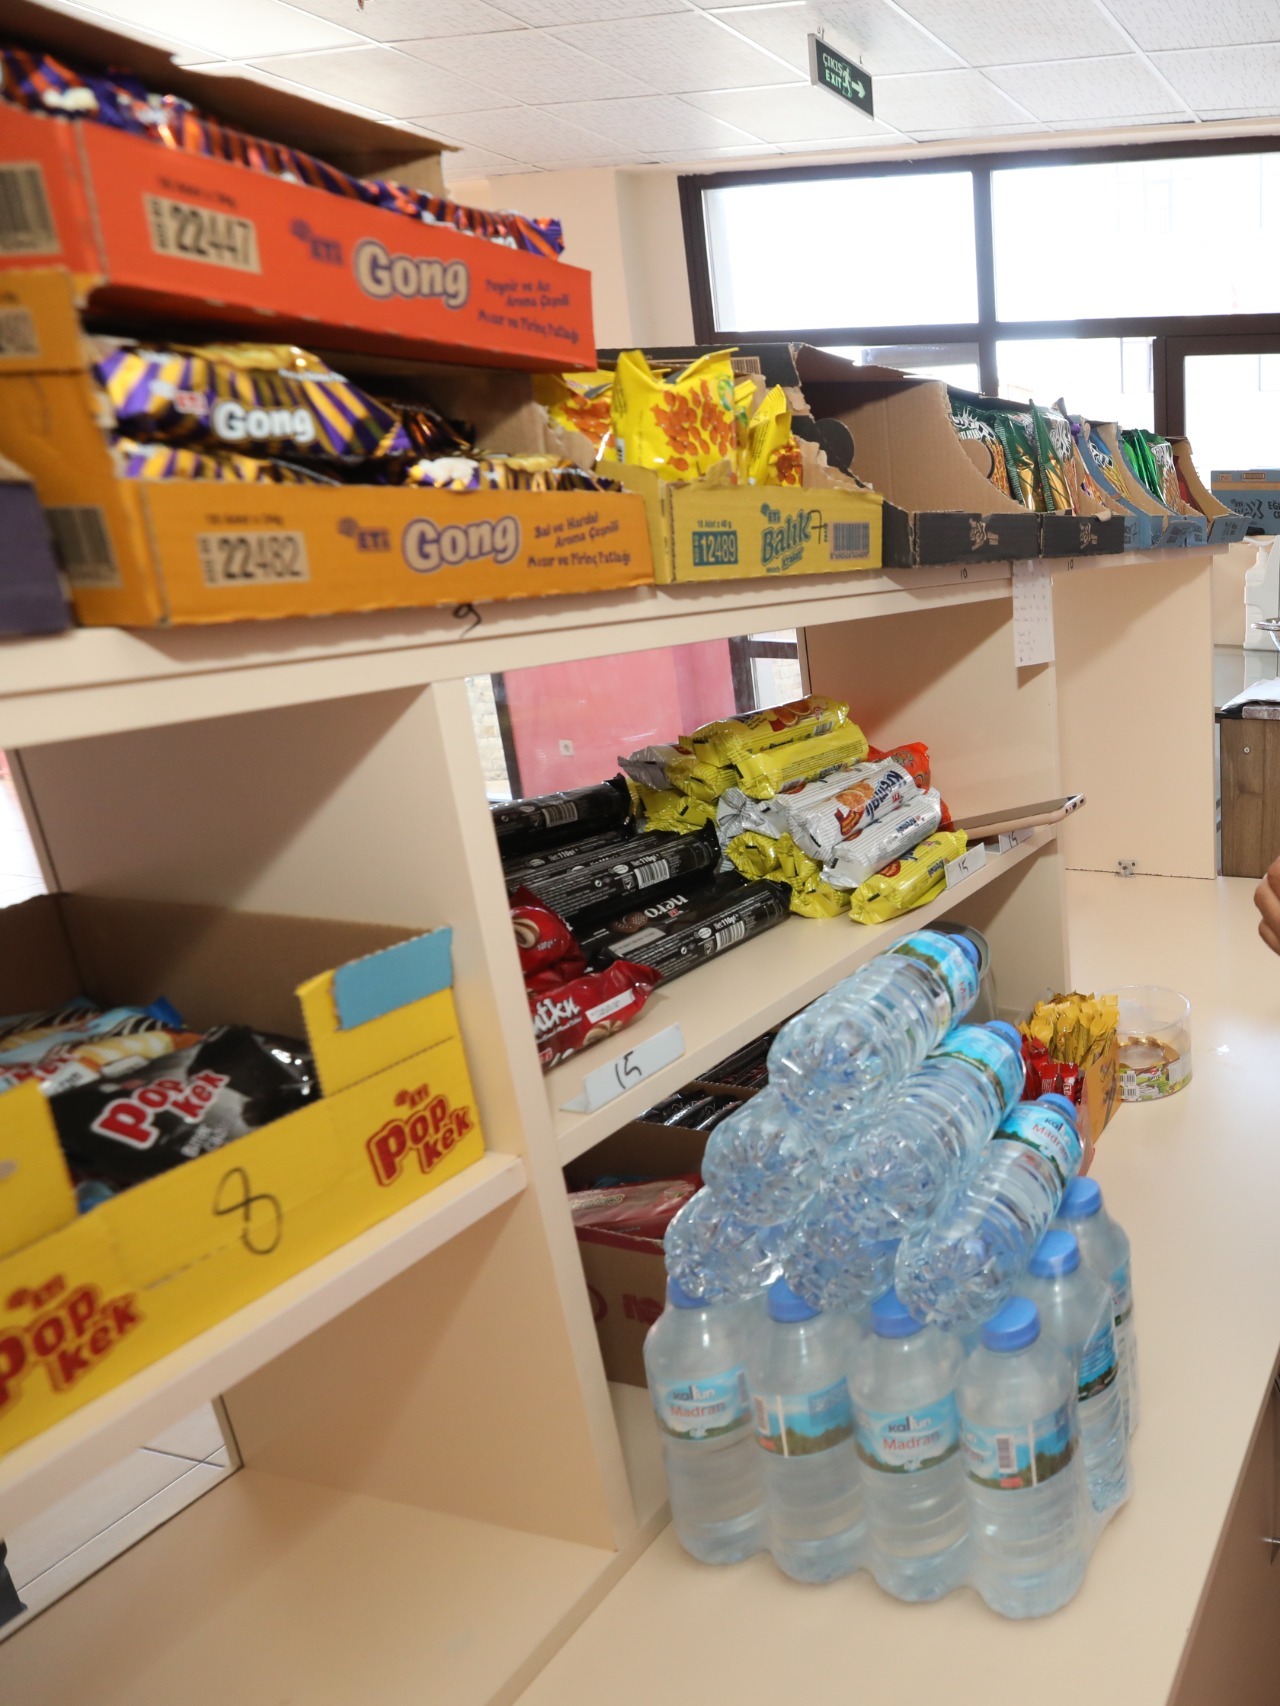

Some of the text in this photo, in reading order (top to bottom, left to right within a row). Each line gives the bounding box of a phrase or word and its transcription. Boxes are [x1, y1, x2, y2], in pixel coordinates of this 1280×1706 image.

[825, 69, 842, 88] EXIT
[355, 238, 470, 311] Gong
[212, 401, 316, 443] Gong
[403, 515, 521, 574] Gong
[700, 534, 737, 563] 12489
[644, 894, 689, 919] nero
[614, 1050, 643, 1090] 15
[669, 1401, 727, 1418] Madran
[882, 1430, 942, 1451] Madran
